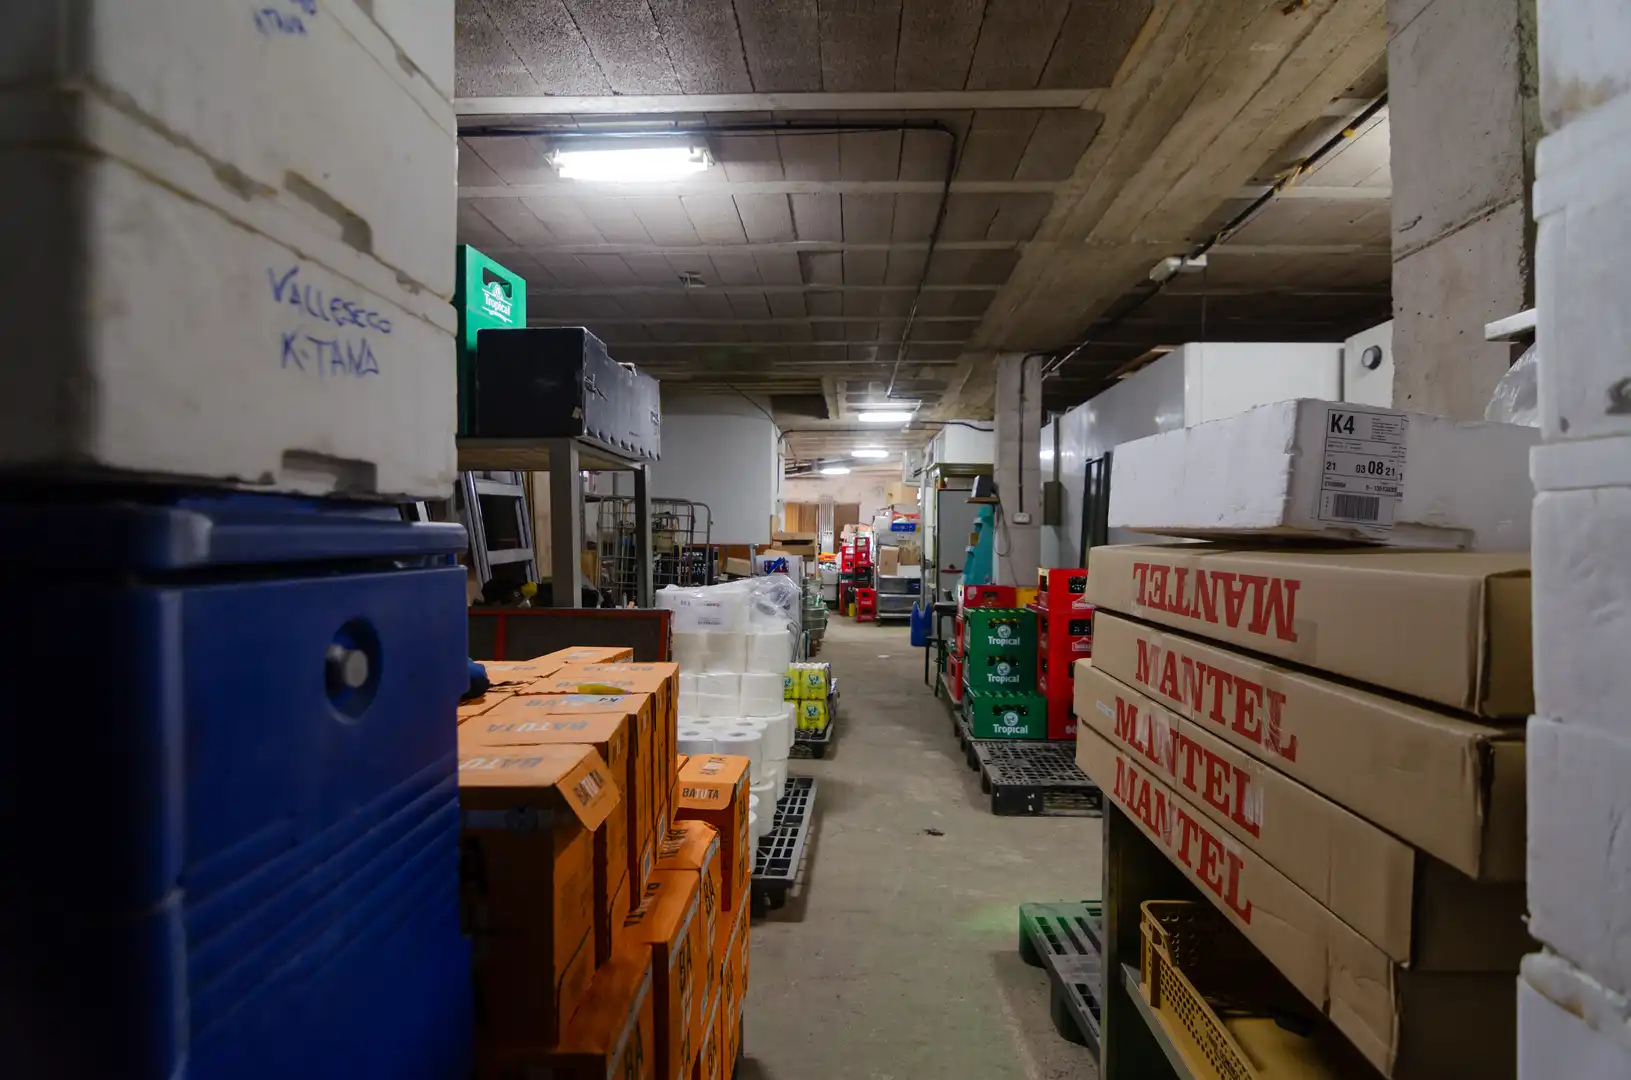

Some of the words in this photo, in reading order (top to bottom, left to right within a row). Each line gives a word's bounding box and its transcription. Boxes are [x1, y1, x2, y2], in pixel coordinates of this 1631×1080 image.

[484, 291, 511, 317] Tropical
[1330, 413, 1355, 434] K4
[1326, 461, 1336, 471] 21
[1355, 464, 1366, 474] 03
[1368, 460, 1384, 475] 08
[1385, 467, 1395, 477] 21
[1133, 562, 1302, 643] MANTEL
[987, 635, 1021, 646] Tropical
[986, 673, 1020, 684] Tropical
[1135, 638, 1299, 763] MANTEL
[487, 722, 589, 733] BATUTA
[993, 724, 1029, 735] Tropical
[1113, 696, 1260, 839] MANTEL
[573, 769, 605, 807] BATUTA
[682, 787, 719, 799] BATUTA
[1113, 756, 1253, 926] MANTEL
